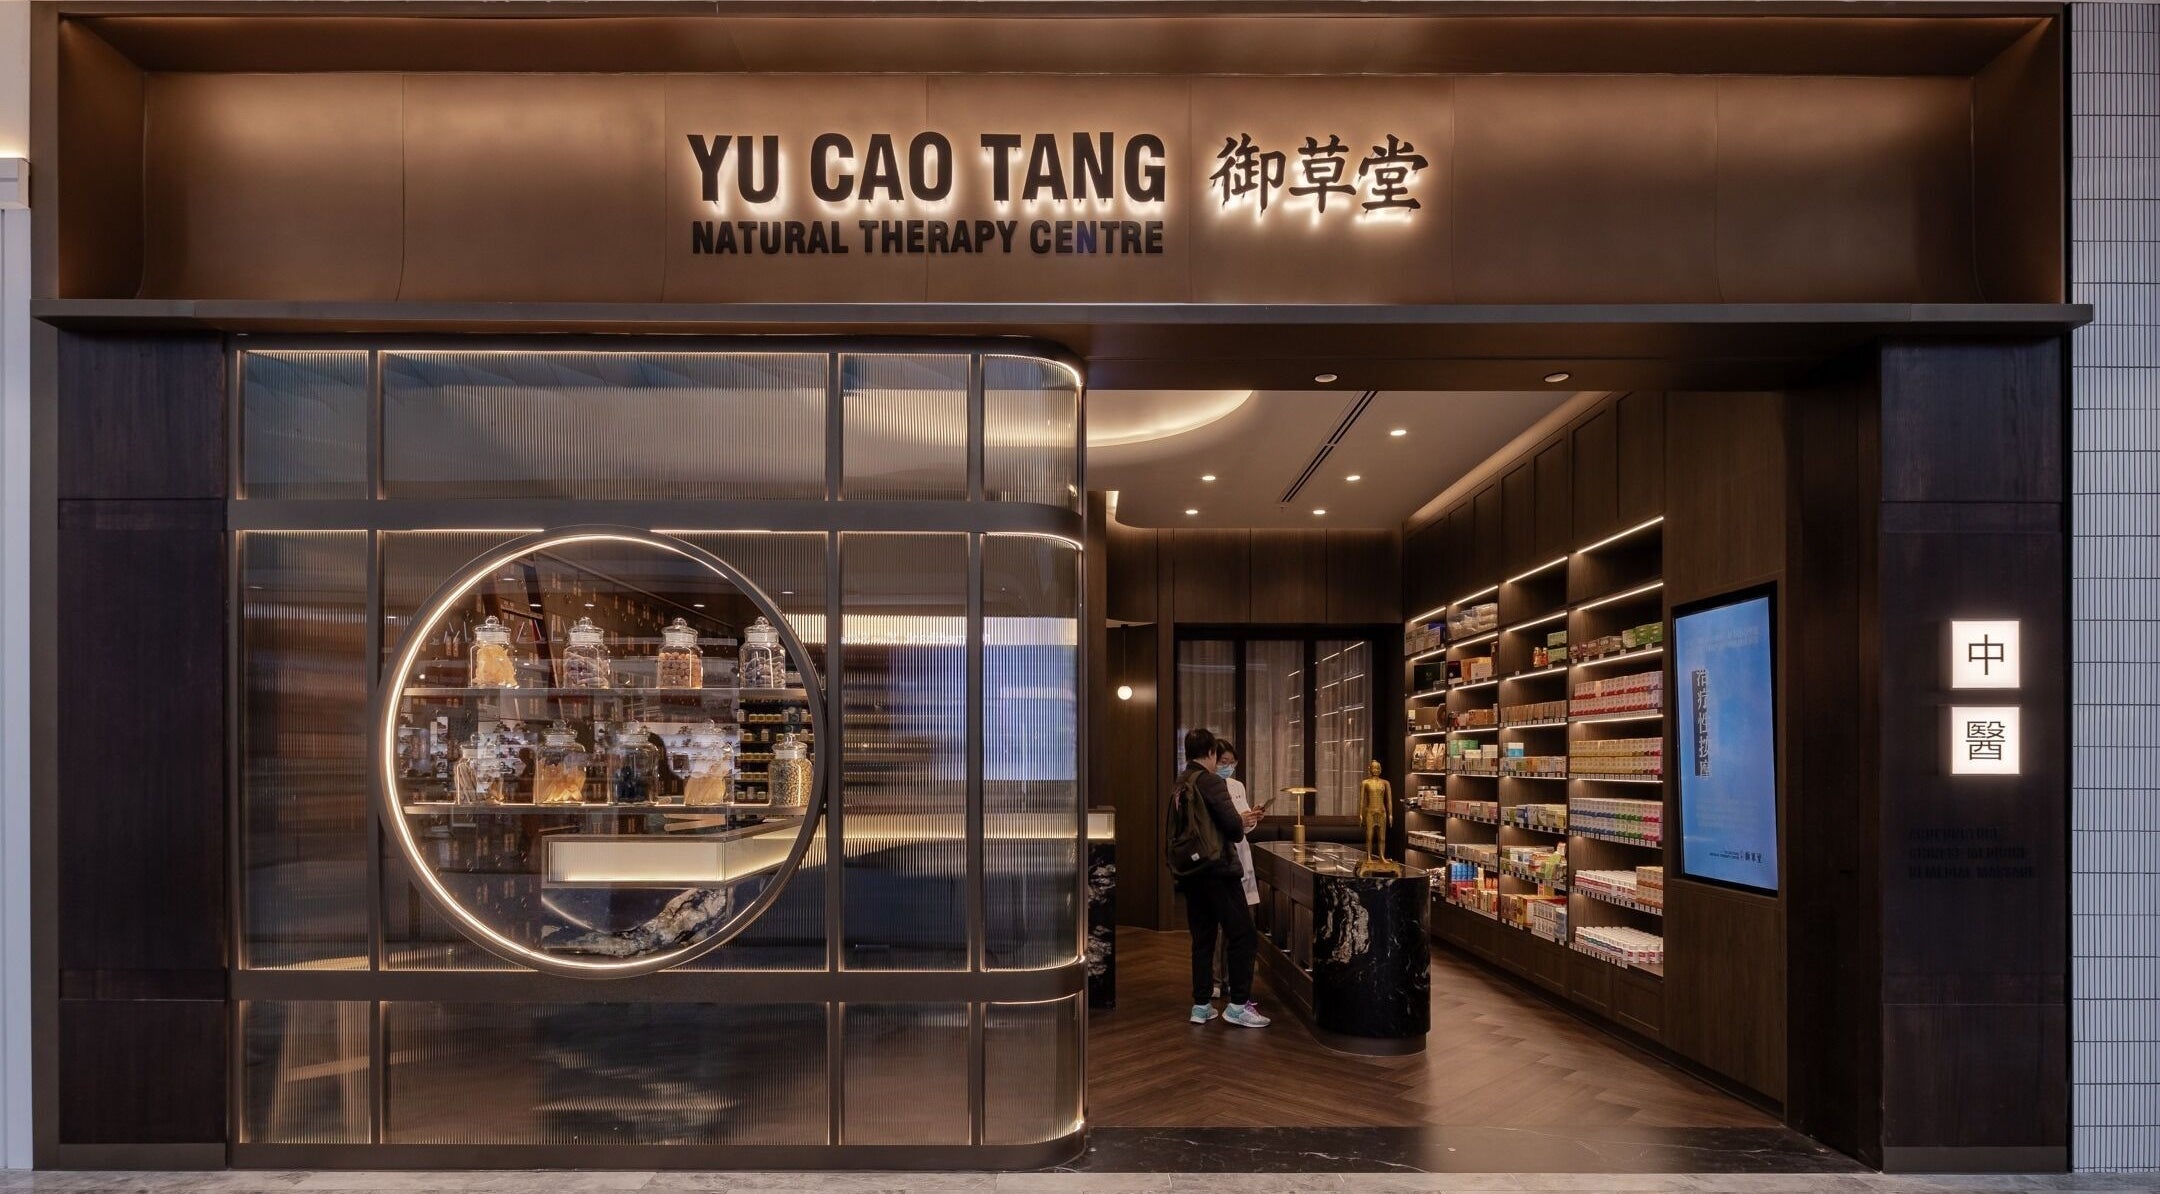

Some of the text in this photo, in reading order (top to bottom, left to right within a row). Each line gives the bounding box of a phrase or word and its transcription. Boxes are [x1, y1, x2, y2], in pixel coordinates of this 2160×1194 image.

[686, 132, 1166, 203] YU CAO TANG
[1209, 132, 1429, 213] 御草堂
[691, 219, 1164, 256] NATURAL THERAPY CENTRE
